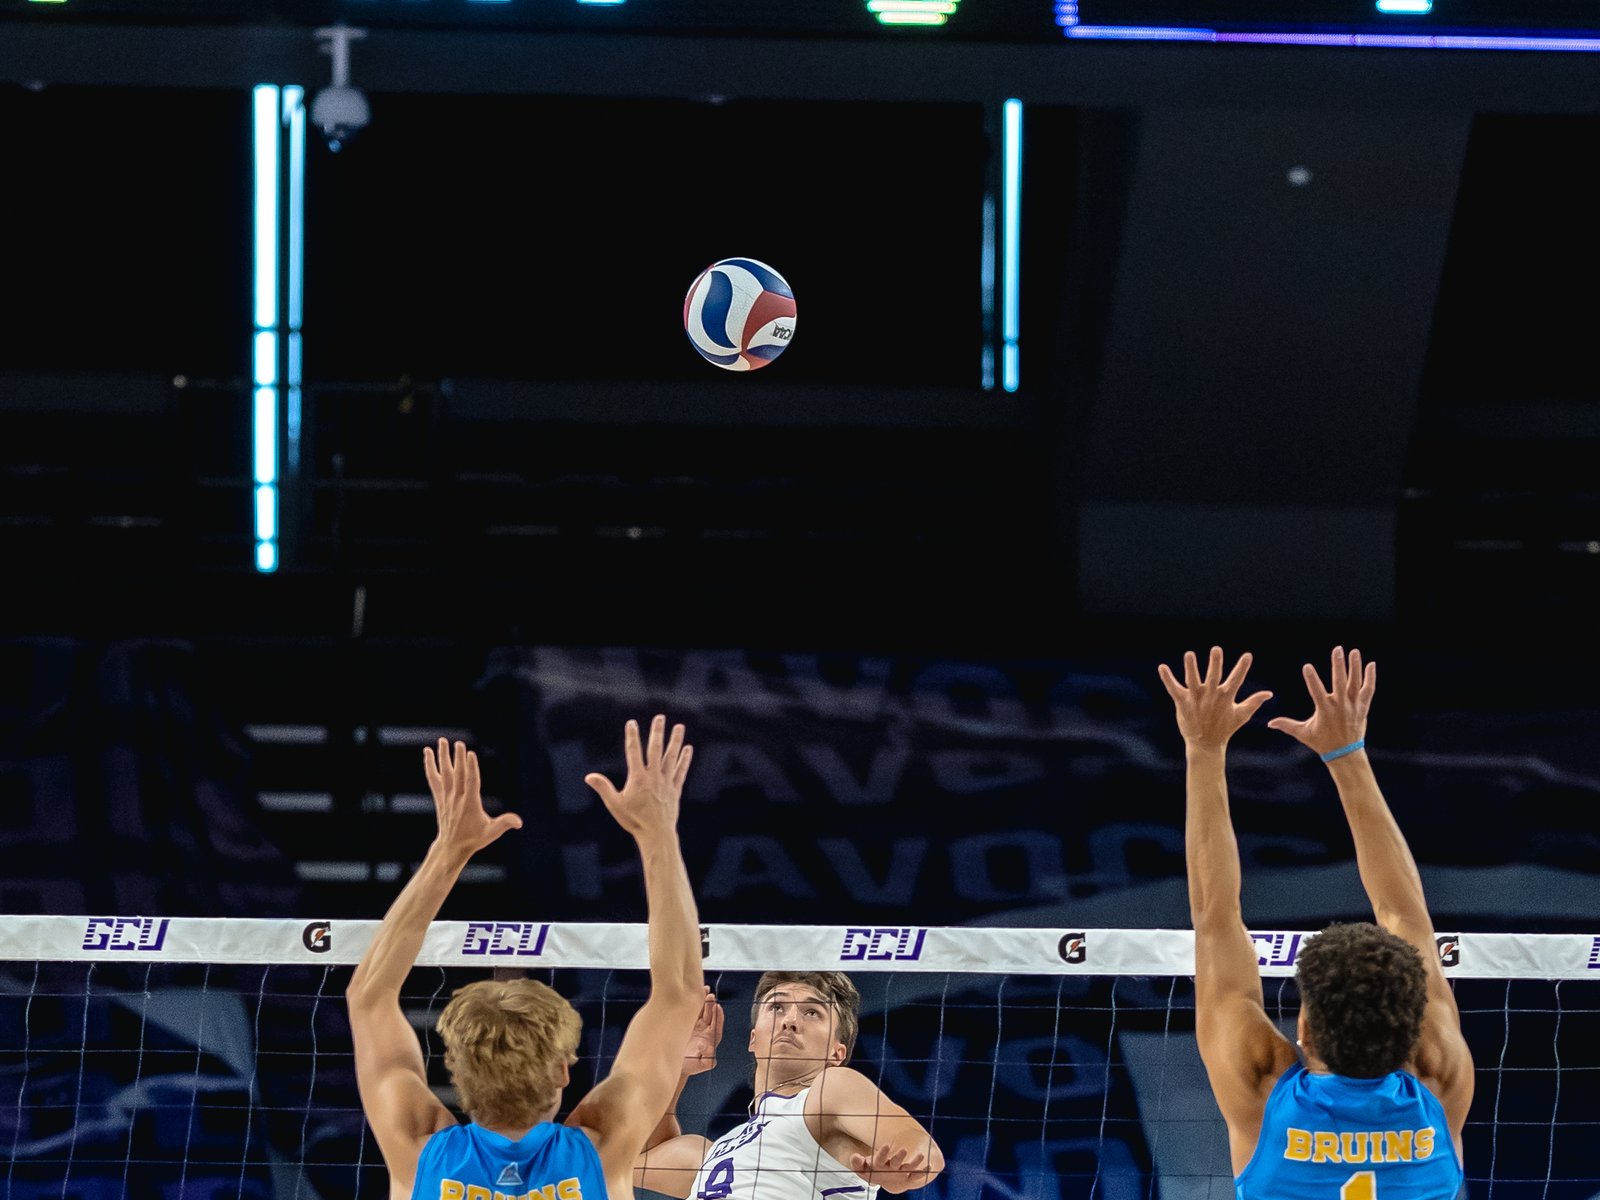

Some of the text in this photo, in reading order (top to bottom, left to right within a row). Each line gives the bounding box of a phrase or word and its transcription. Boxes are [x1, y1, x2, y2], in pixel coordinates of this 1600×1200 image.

[772, 326, 792, 340] CAA
[82, 917, 170, 951] GCU
[302, 921, 332, 953] G
[462, 923, 551, 956] GCU
[840, 928, 928, 961] GCU
[1057, 932, 1087, 964] G
[1249, 934, 1302, 967] CU
[1283, 1126, 1436, 1164] BRUINS
